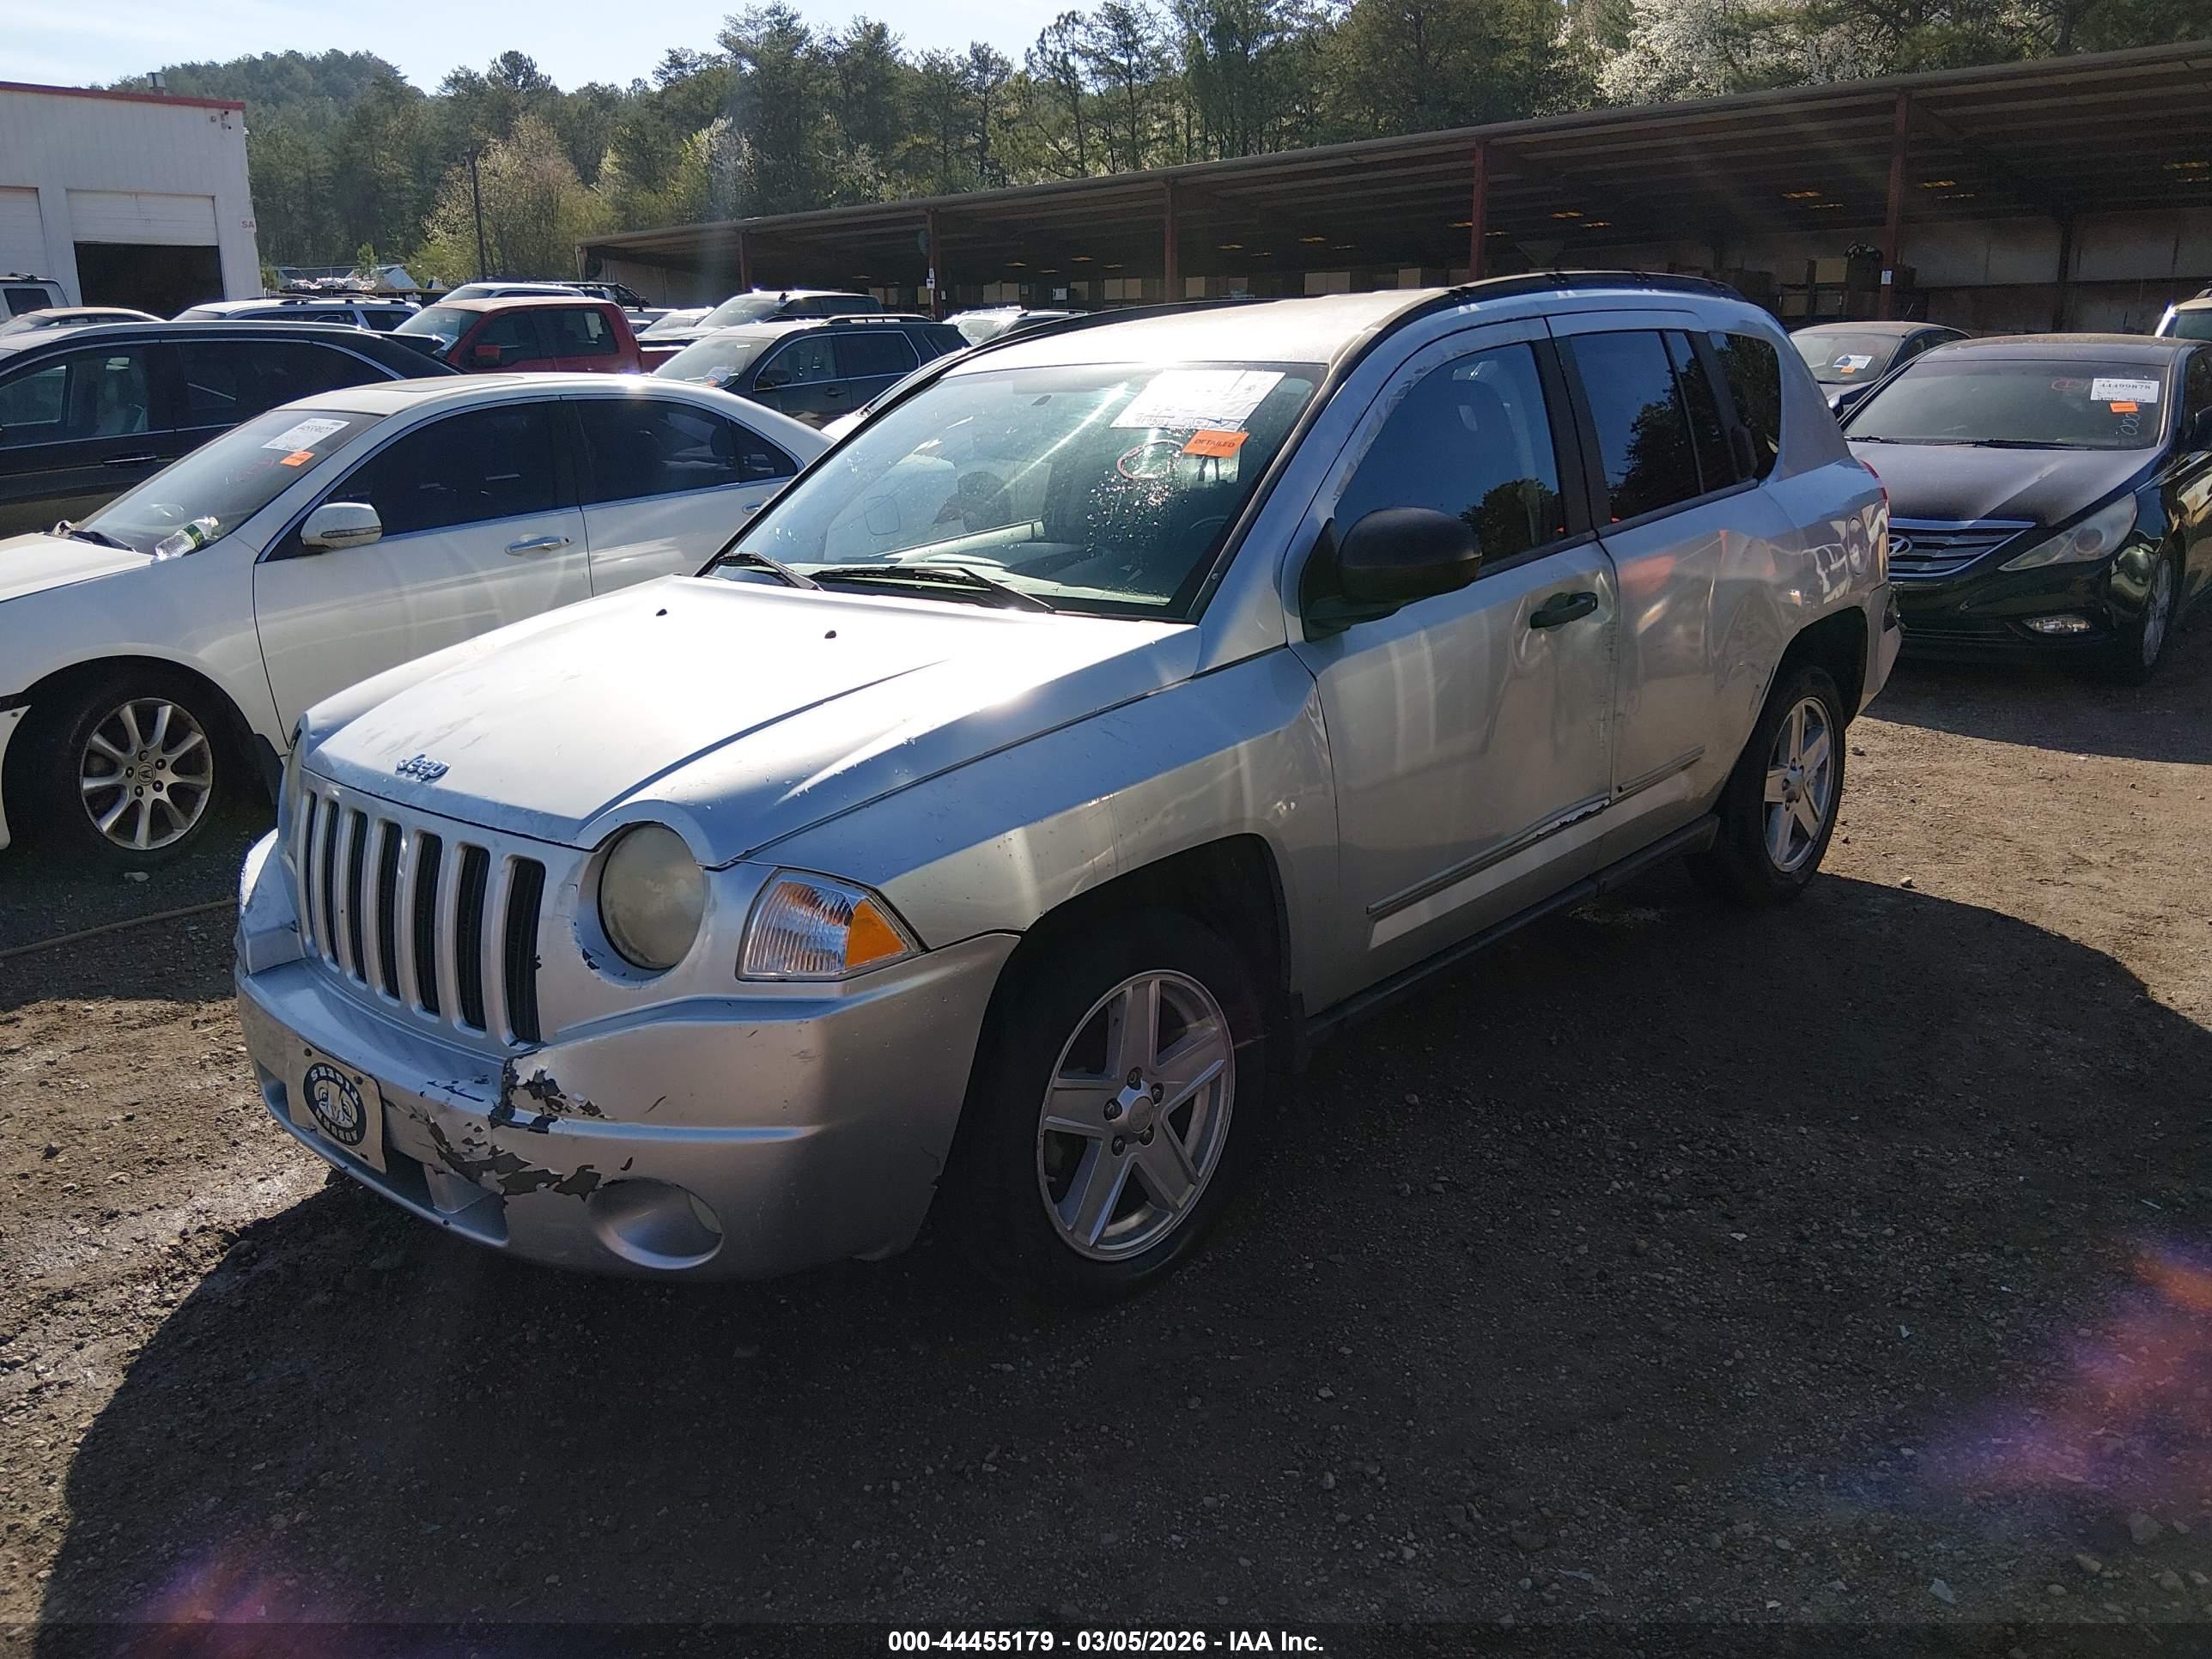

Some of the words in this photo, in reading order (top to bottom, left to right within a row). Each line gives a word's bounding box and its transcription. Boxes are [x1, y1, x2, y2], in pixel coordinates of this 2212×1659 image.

[1194, 439, 1236, 448] DETAILED
[397, 753, 452, 782] Jeep
[310, 1065, 360, 1106] TIGERS
[315, 1108, 358, 1142] AUBURN
